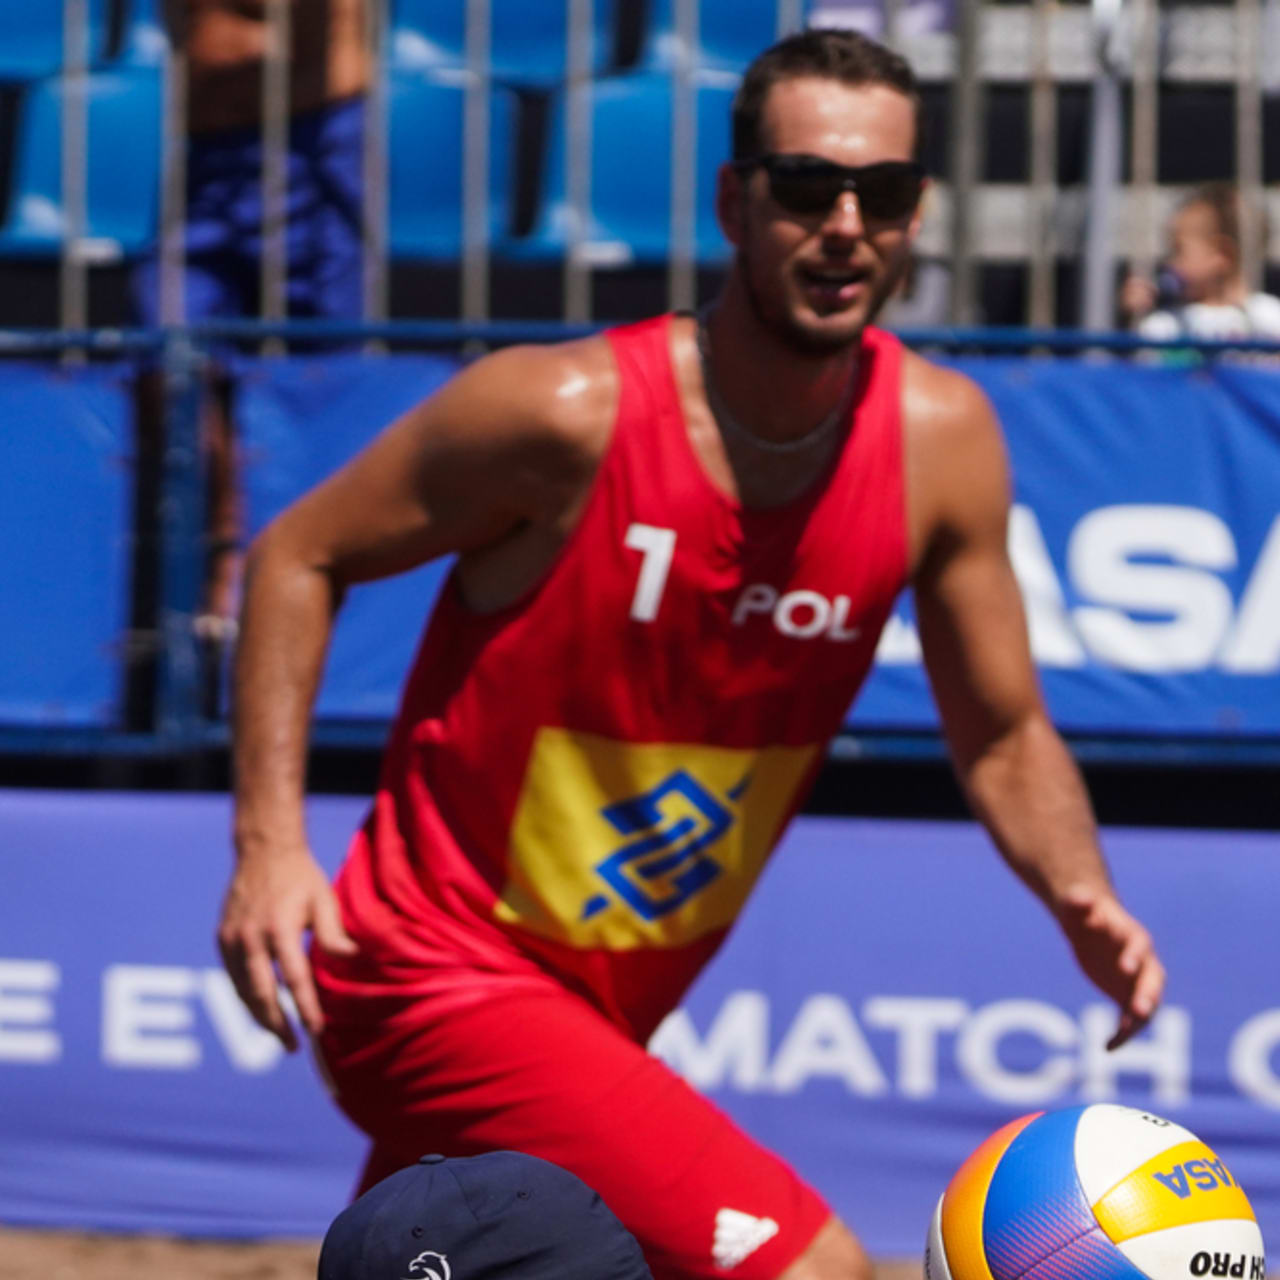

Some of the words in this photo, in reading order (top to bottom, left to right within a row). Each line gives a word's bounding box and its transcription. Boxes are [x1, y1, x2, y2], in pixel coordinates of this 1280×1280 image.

[625, 523, 677, 622] 1
[732, 583, 860, 641] POL
[648, 990, 1191, 1107] MATCH
[1153, 1158, 1240, 1199] ASA
[1190, 1251, 1246, 1279] PRO
